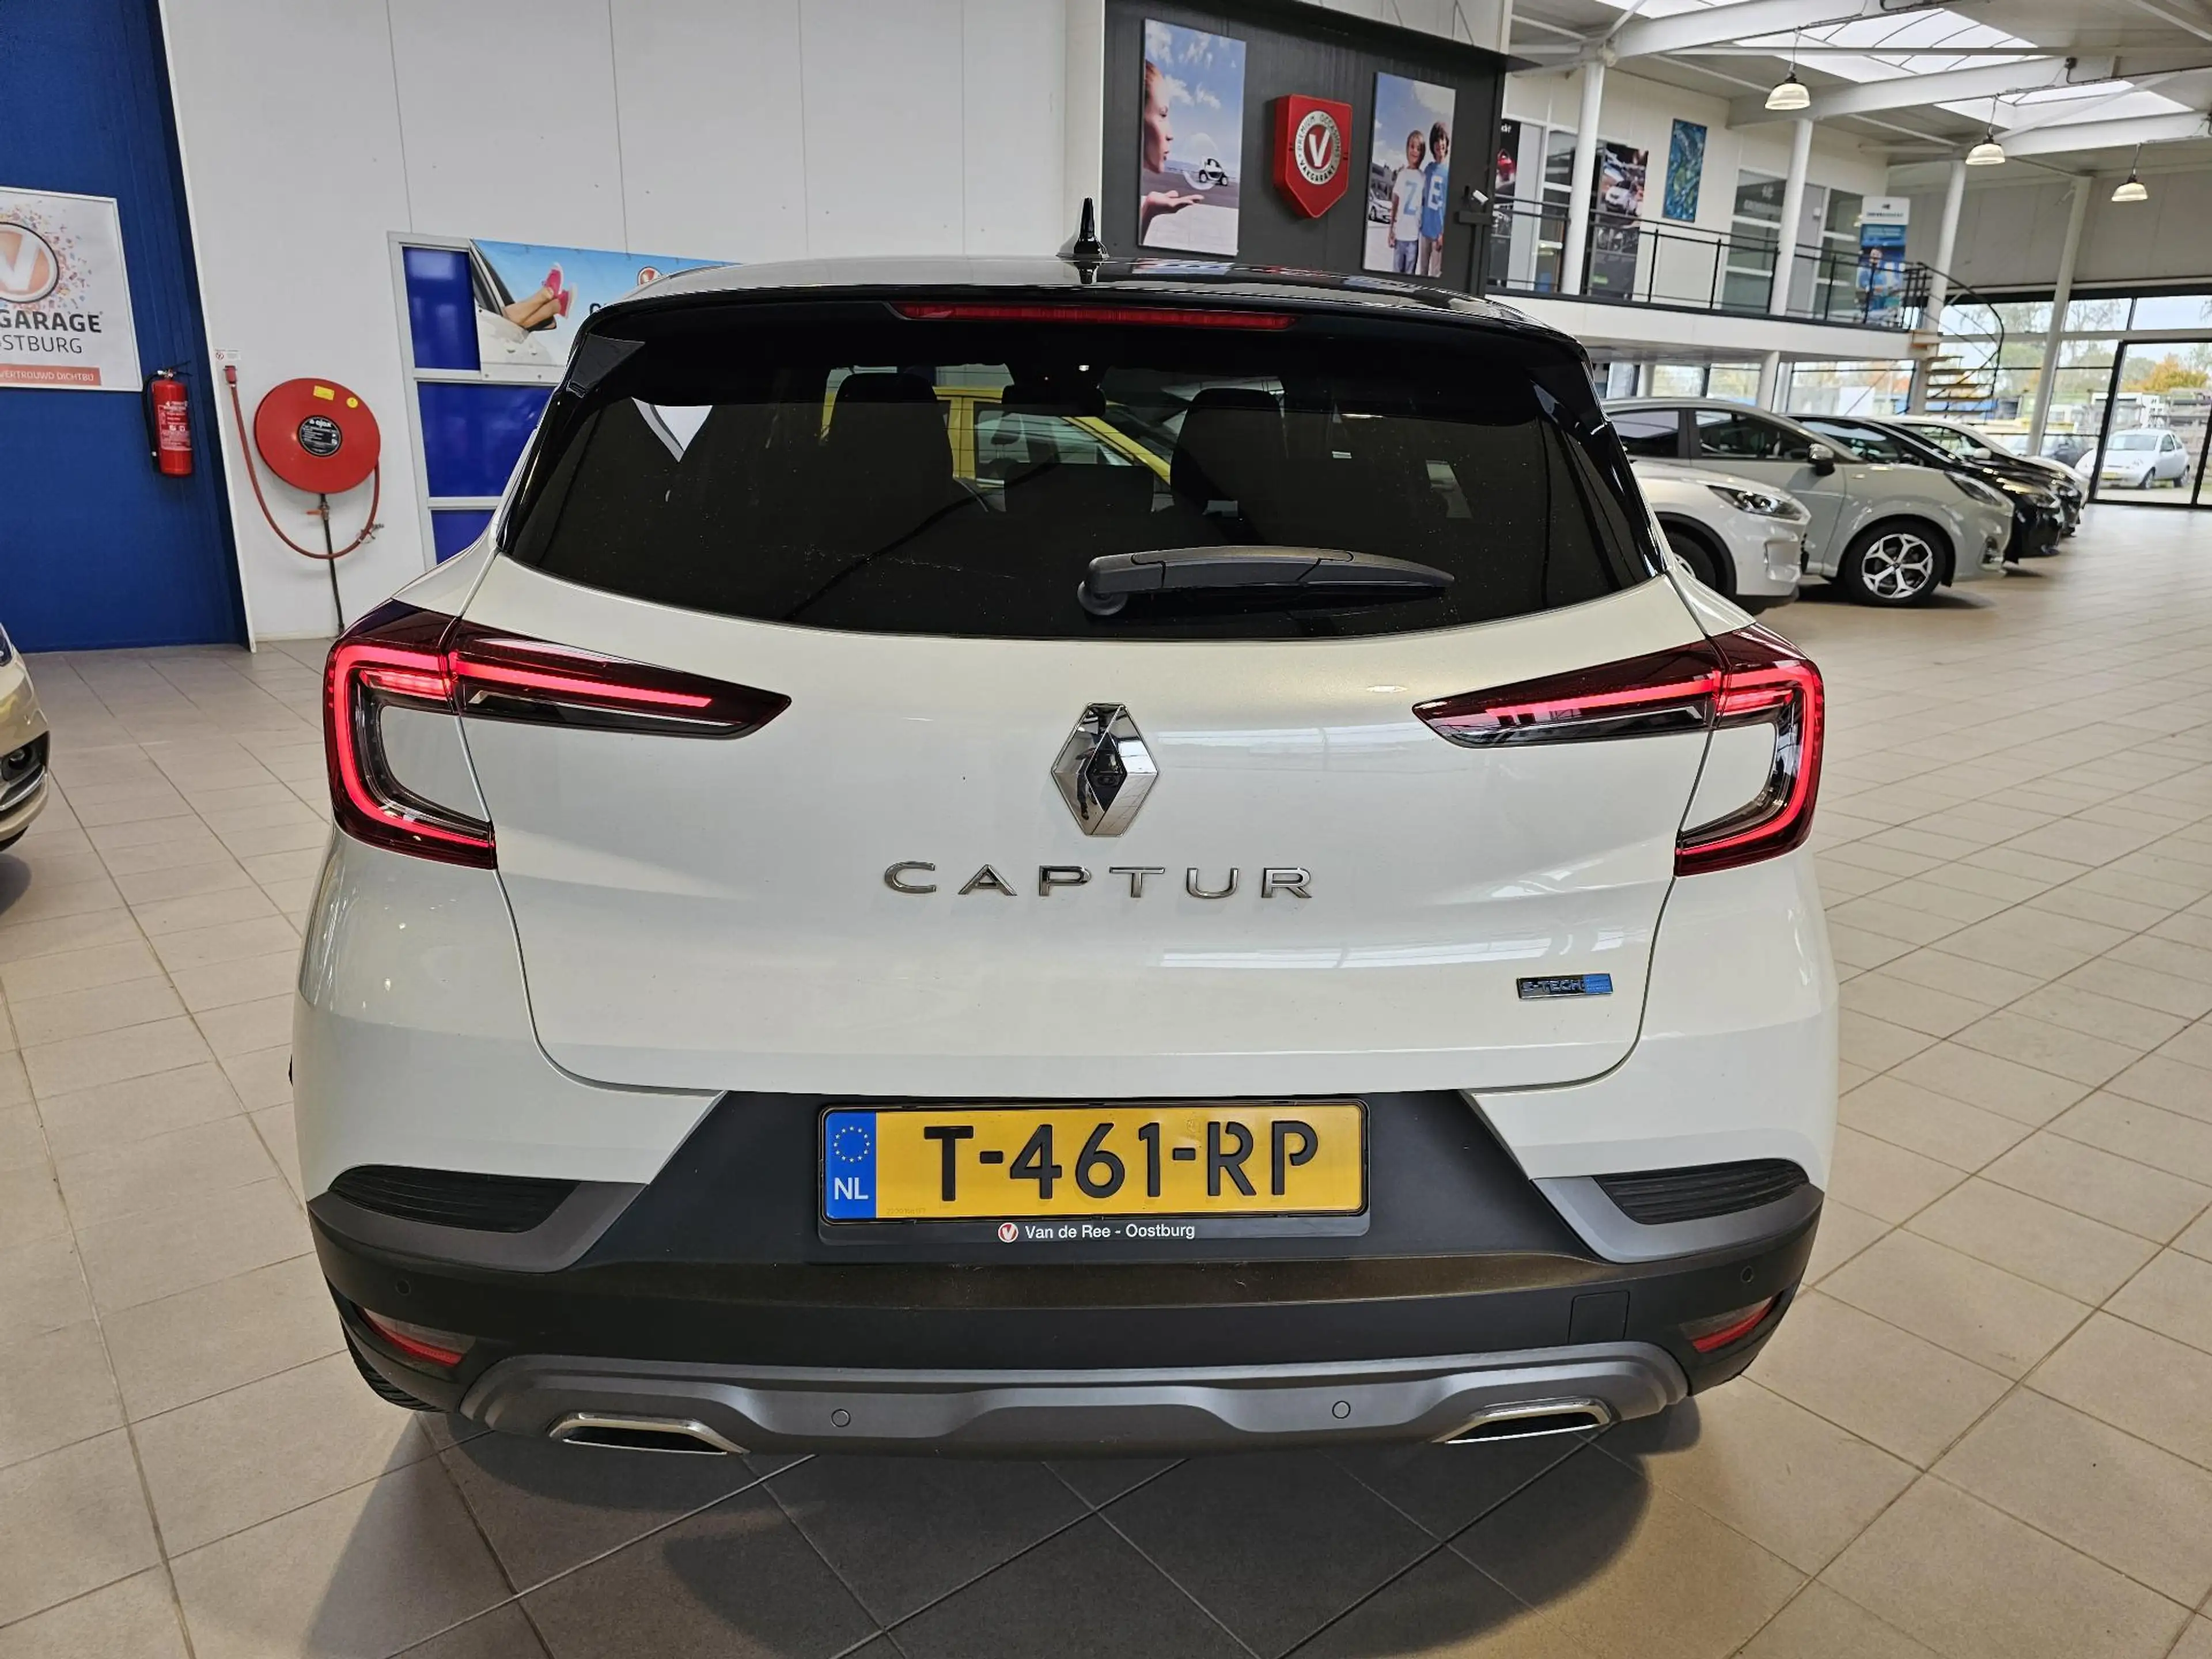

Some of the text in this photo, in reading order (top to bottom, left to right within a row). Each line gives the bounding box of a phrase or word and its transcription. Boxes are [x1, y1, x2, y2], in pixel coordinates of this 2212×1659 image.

[1403, 180, 1418, 215] Z
[0, 309, 103, 334] GARAGE
[0, 334, 82, 354] STBURG
[884, 861, 1313, 899] CAPTUR
[923, 1120, 1319, 1202] T-461-RP
[834, 1177, 868, 1200] NL
[1025, 1226, 1054, 1238] Van
[1058, 1225, 1077, 1238] de
[1082, 1225, 1111, 1238] Ree
[1126, 1224, 1195, 1239] Oostburg
